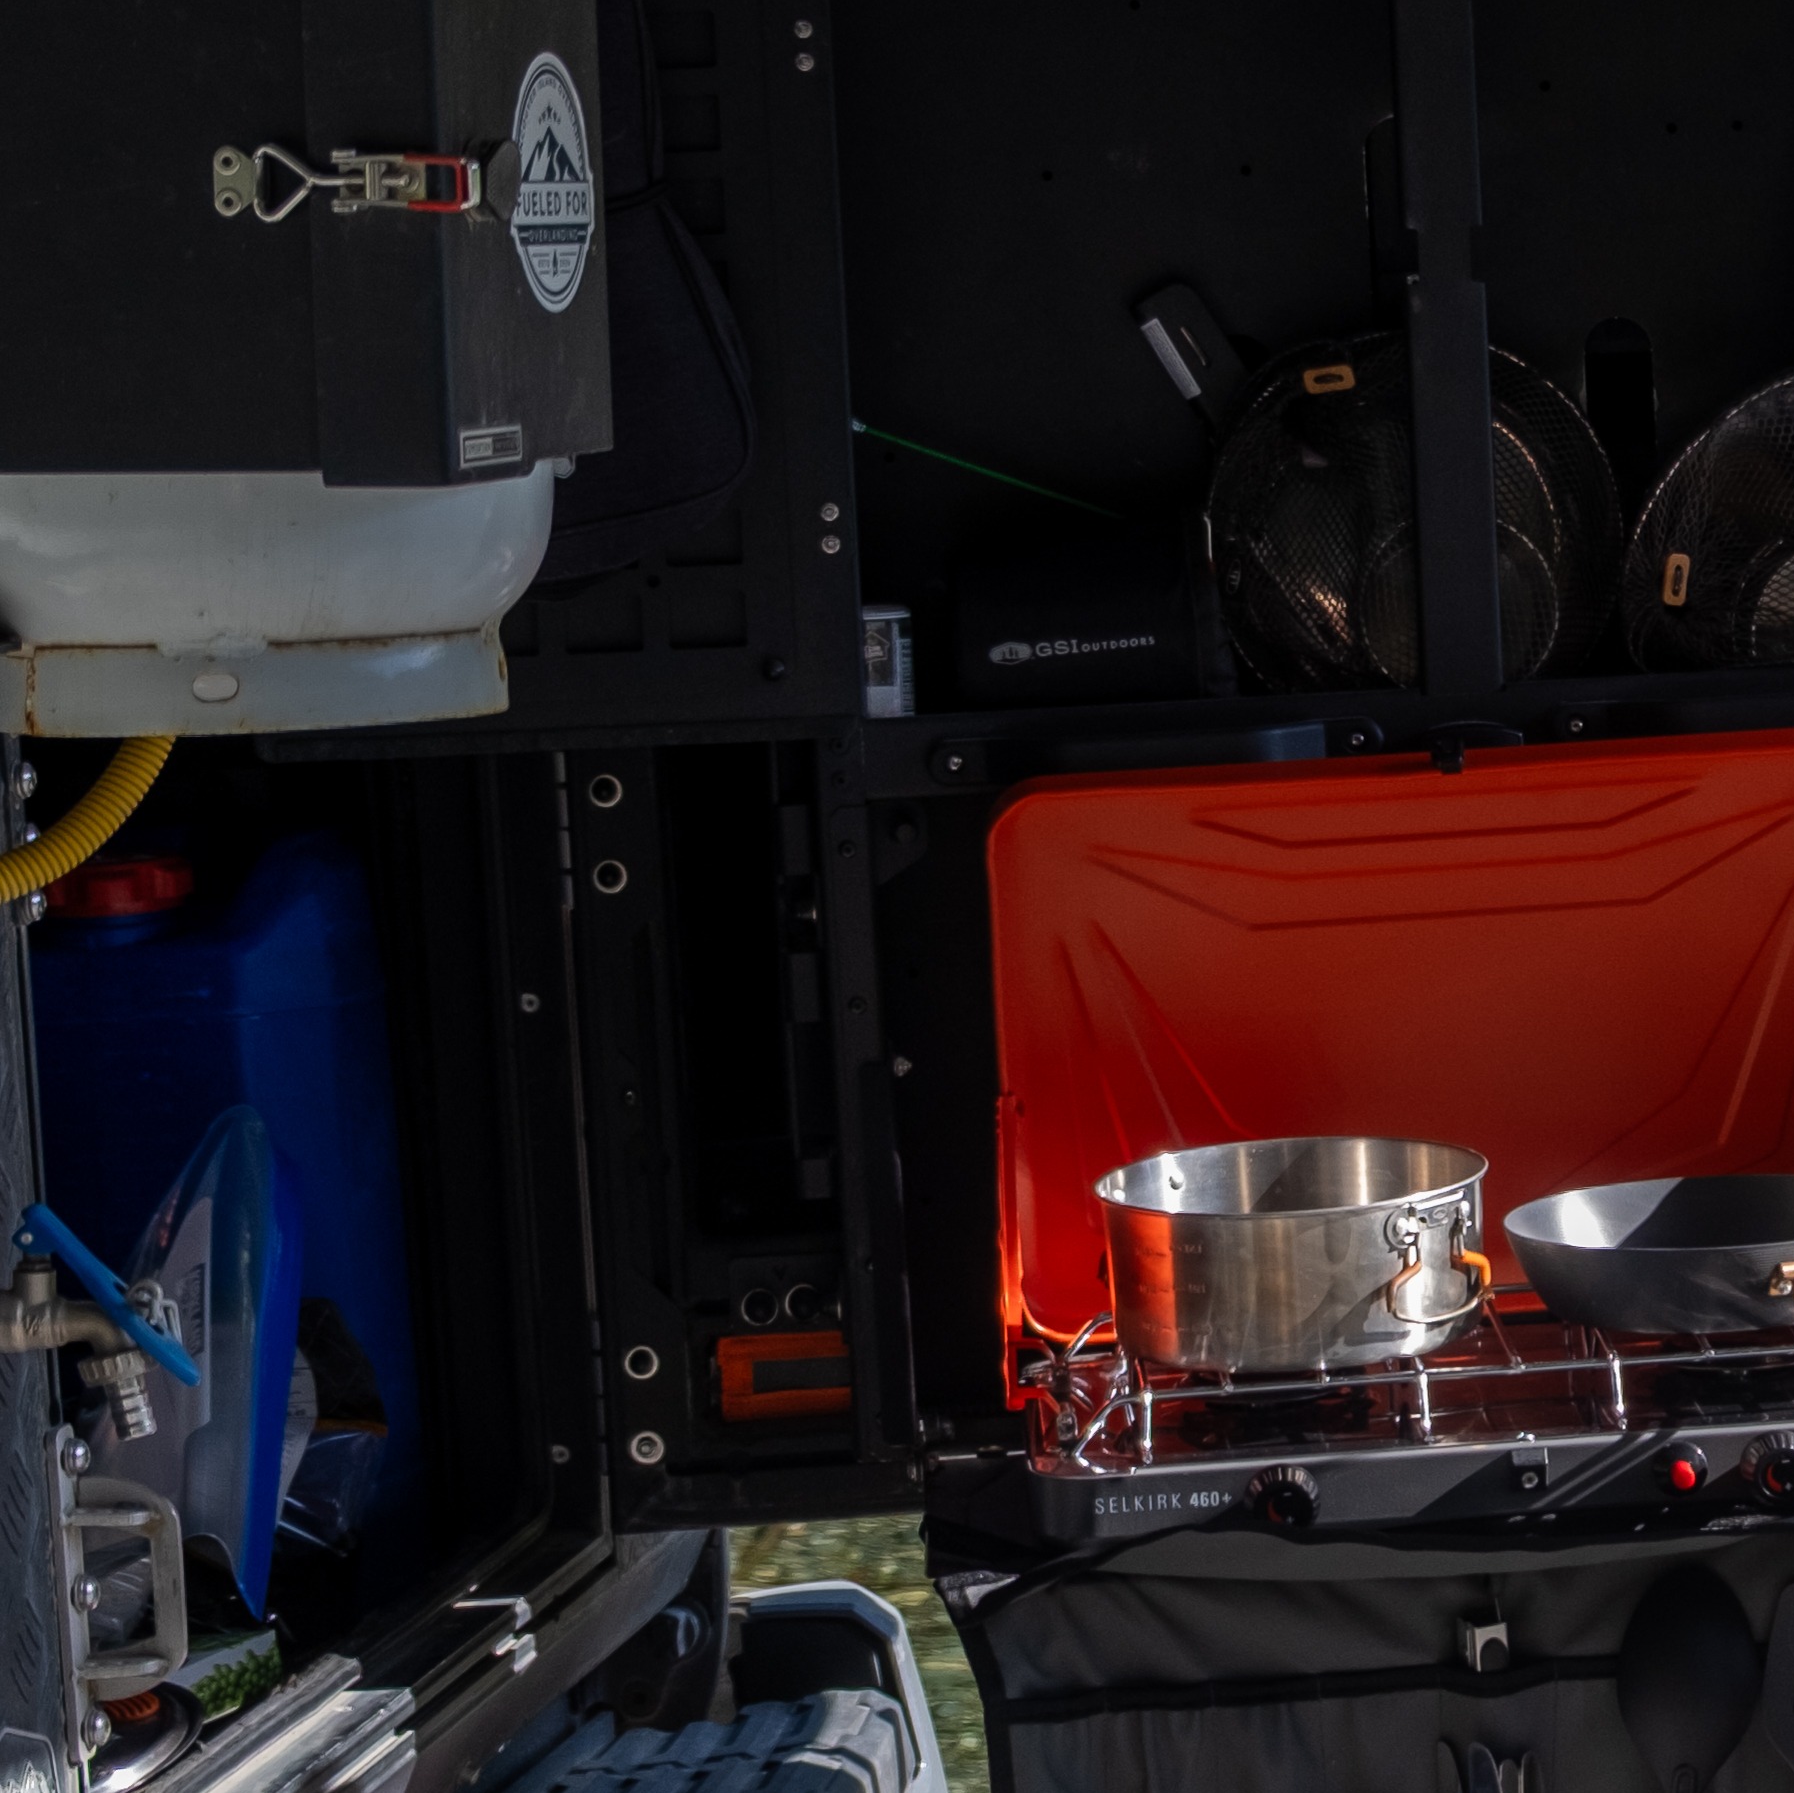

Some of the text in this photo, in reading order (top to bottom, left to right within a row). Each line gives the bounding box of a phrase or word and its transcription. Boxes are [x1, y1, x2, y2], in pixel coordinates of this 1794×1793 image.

[516, 191, 588, 217] FUELED FOR
[1035, 636, 1155, 657] GSI OUTDOORS
[1094, 1491, 1232, 1515] SELKIRK 460+
